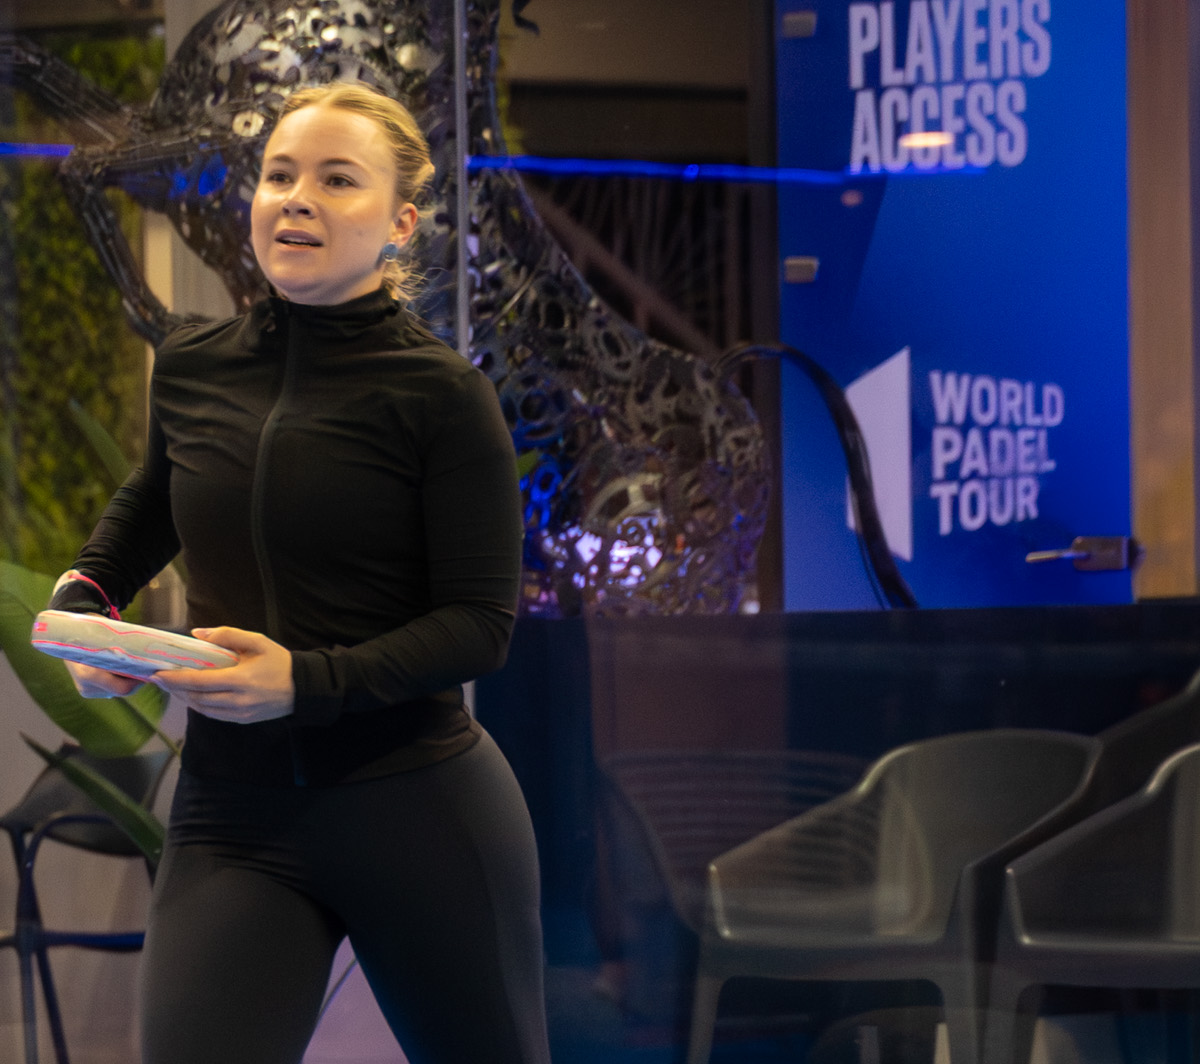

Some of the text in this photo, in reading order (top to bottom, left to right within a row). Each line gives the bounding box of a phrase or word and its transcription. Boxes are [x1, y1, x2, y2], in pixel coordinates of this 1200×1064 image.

[847, 0, 1052, 89] PLAYERS
[851, 81, 1029, 174] ACCESS
[929, 369, 1065, 427] WORLD
[931, 427, 1057, 479] PADEL
[930, 477, 1040, 535] TOUR
